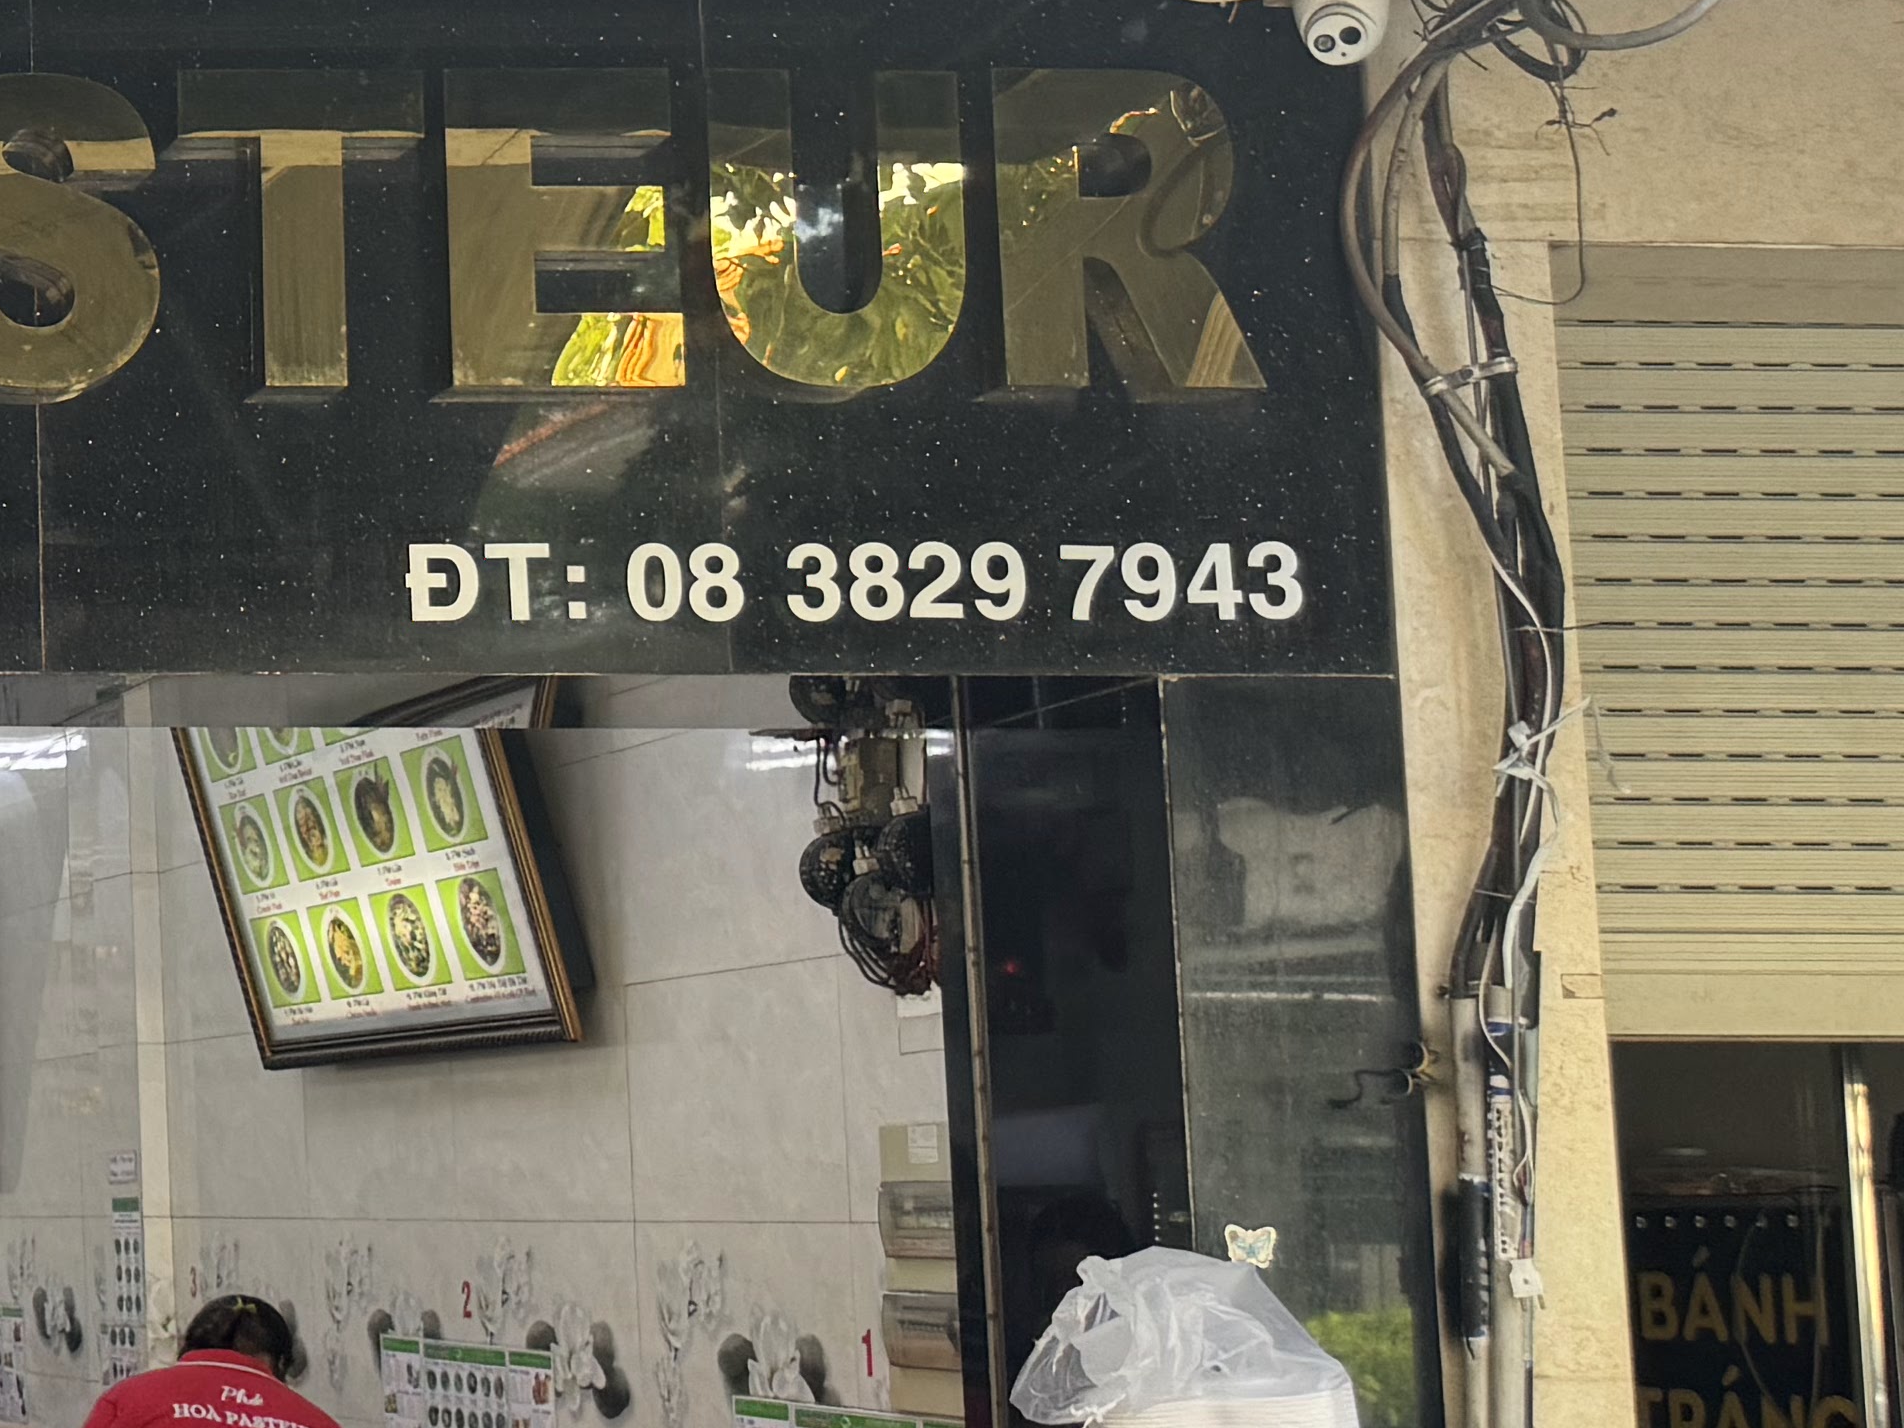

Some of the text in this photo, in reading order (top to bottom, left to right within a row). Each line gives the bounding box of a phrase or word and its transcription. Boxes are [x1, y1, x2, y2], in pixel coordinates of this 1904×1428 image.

[405, 539, 1305, 625] ĐT: 08 3829 7943
[461, 1281, 473, 1319] 2
[1637, 1245, 1829, 1346] BÁNH
[861, 1328, 874, 1377] 1
